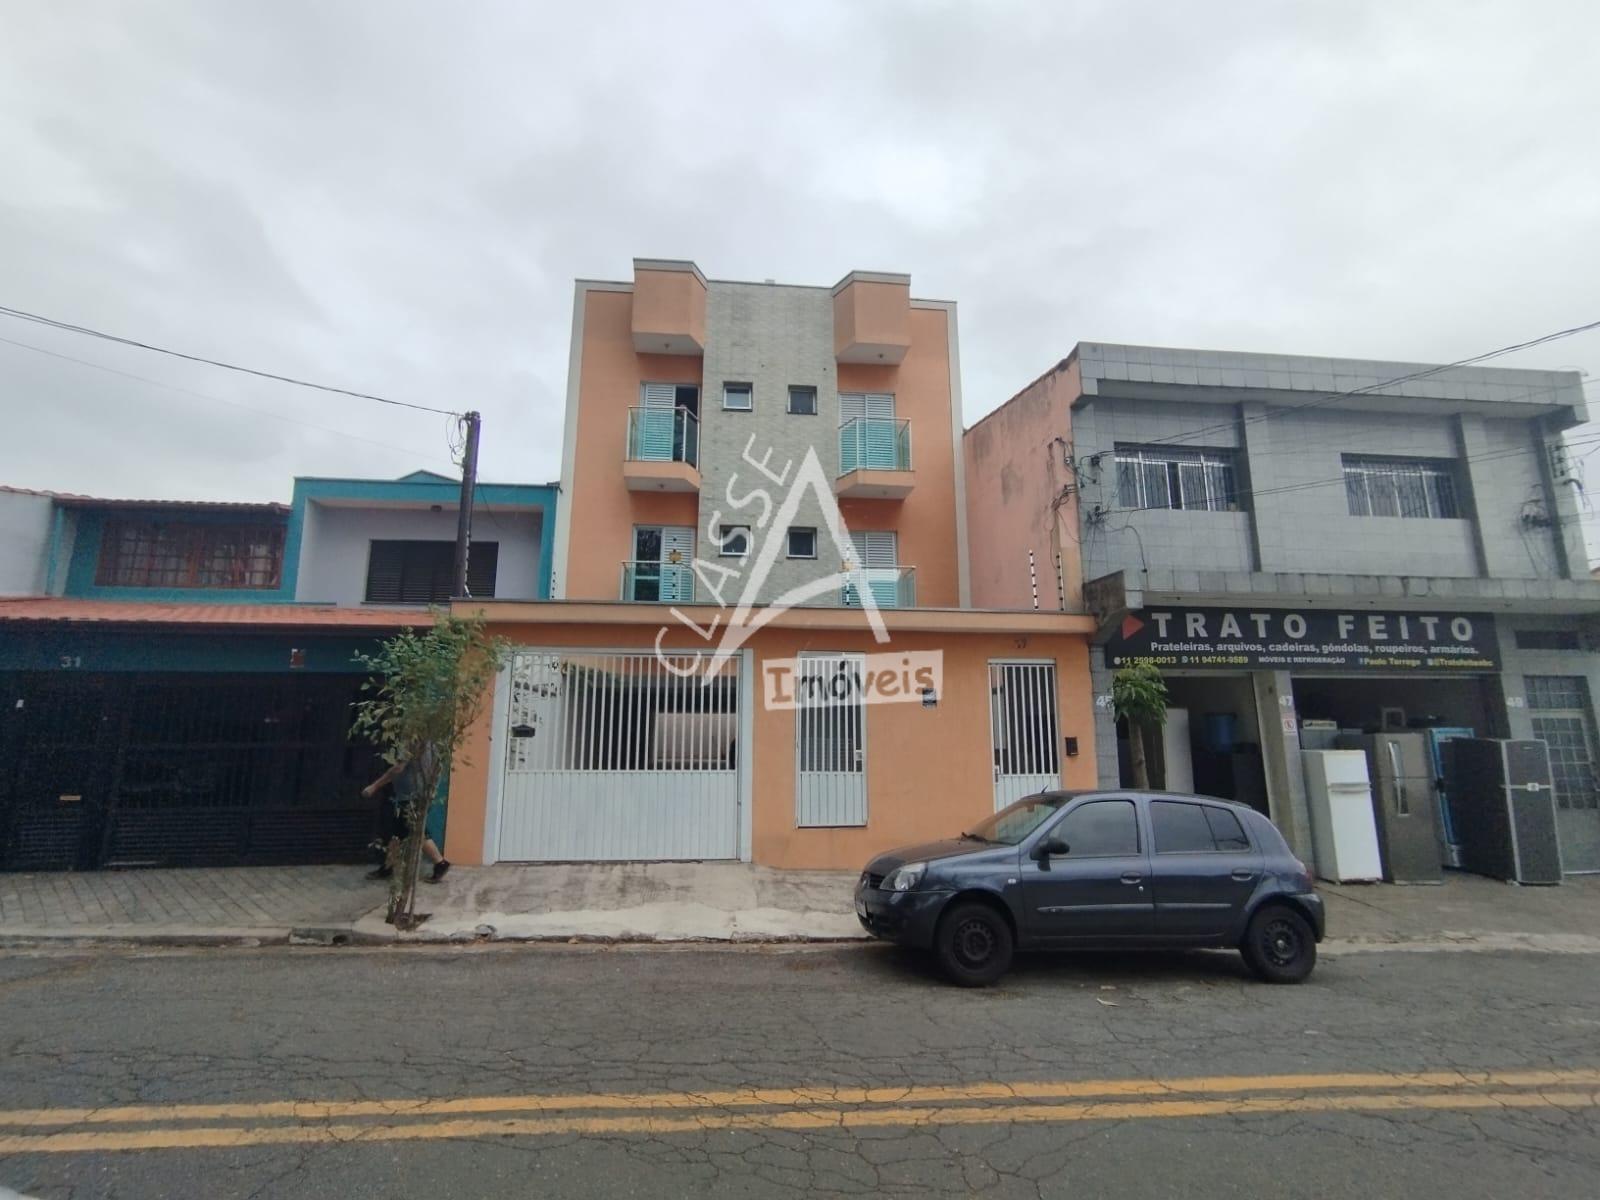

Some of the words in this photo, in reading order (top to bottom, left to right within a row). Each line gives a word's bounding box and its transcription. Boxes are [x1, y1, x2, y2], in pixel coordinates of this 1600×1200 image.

[1151, 612, 1307, 639] TRATO
[1337, 614, 1473, 641] FEITO
[1151, 641, 1214, 653] Prateleiras,
[1216, 642, 1266, 653] arquivos,
[1268, 642, 1320, 653] cadeiras,
[1375, 643, 1428, 655] roupeiros,
